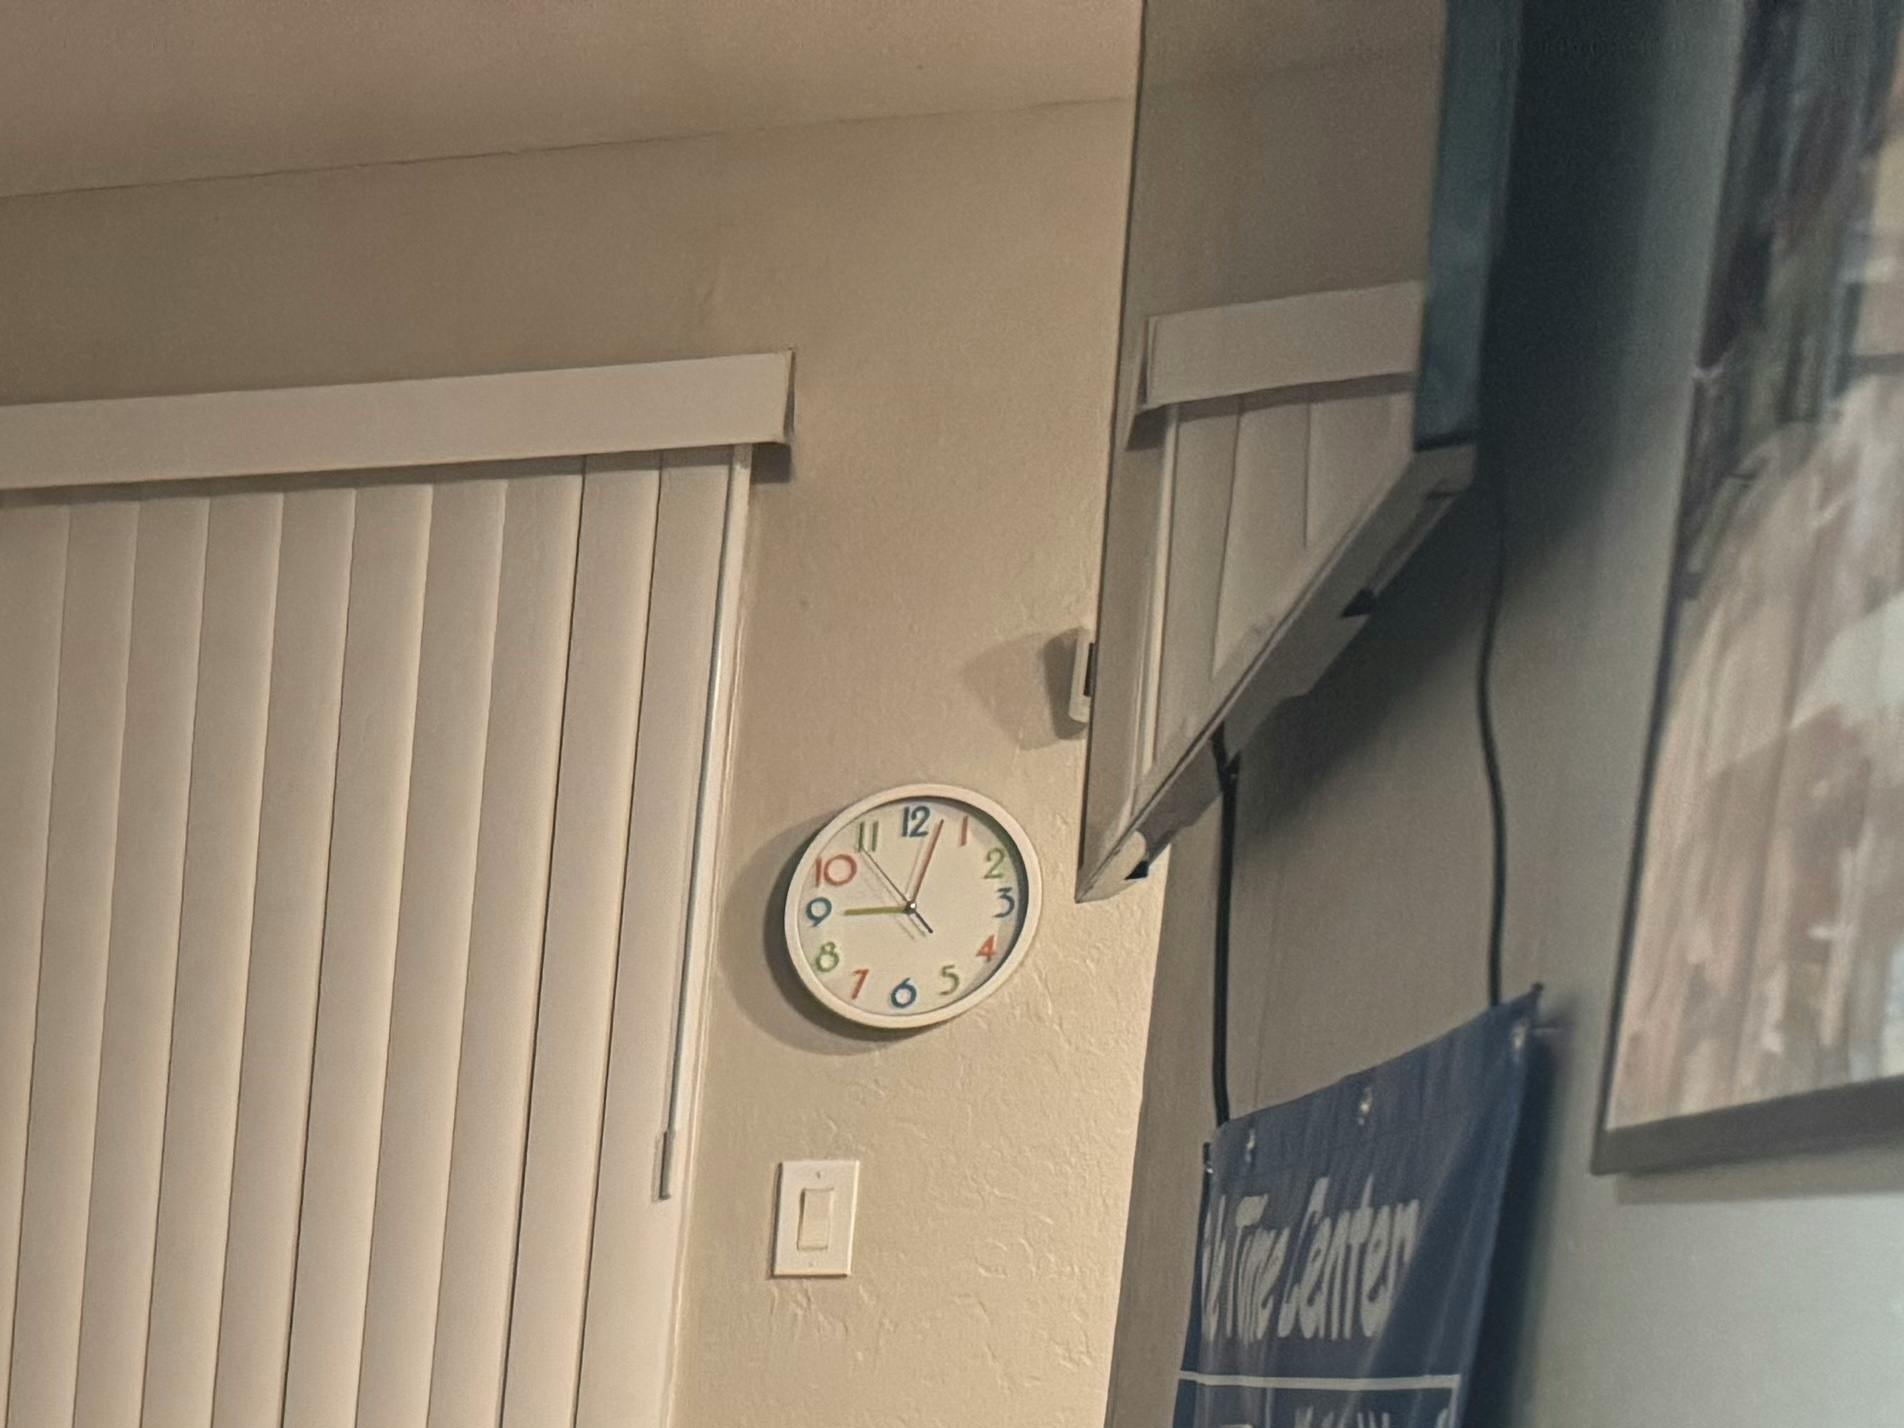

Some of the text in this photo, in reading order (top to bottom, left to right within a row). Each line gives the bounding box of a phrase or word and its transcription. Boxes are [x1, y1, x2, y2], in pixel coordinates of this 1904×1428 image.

[857, 821, 878, 852] 11
[901, 806, 930, 837] 12
[959, 815, 968, 847] 1
[815, 853, 857, 887] 10
[984, 848, 1005, 879] 2
[806, 896, 832, 926] 9
[994, 887, 1015, 918] 3
[815, 941, 840, 973] 8
[977, 934, 998, 962] 4
[851, 968, 869, 1000] 7
[891, 977, 917, 1008] 6
[940, 965, 960, 995] 5
